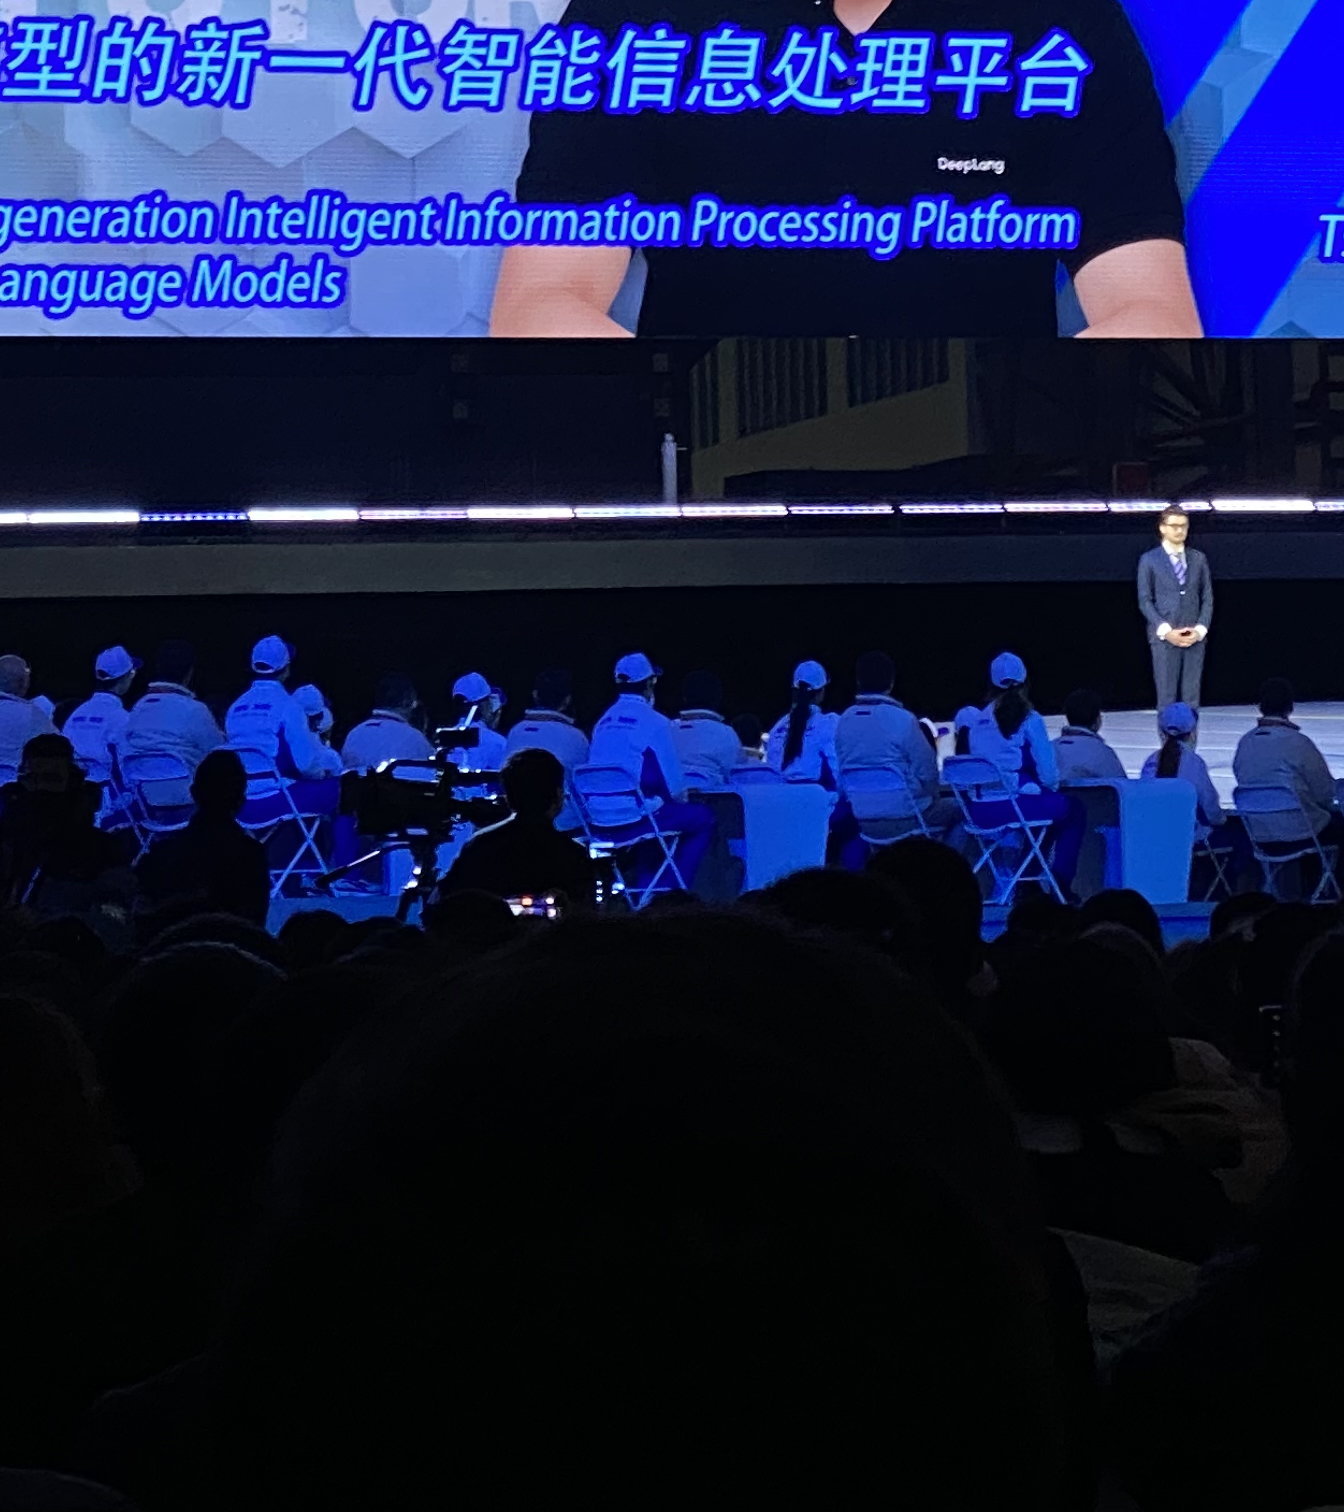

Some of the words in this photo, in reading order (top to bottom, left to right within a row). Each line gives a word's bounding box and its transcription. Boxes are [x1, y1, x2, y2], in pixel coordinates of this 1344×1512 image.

[226, 197, 434, 252] Intelligent
[444, 200, 682, 241] Information
[690, 200, 901, 252] Processing
[910, 199, 1077, 245] Platform
[192, 258, 343, 305] Models
